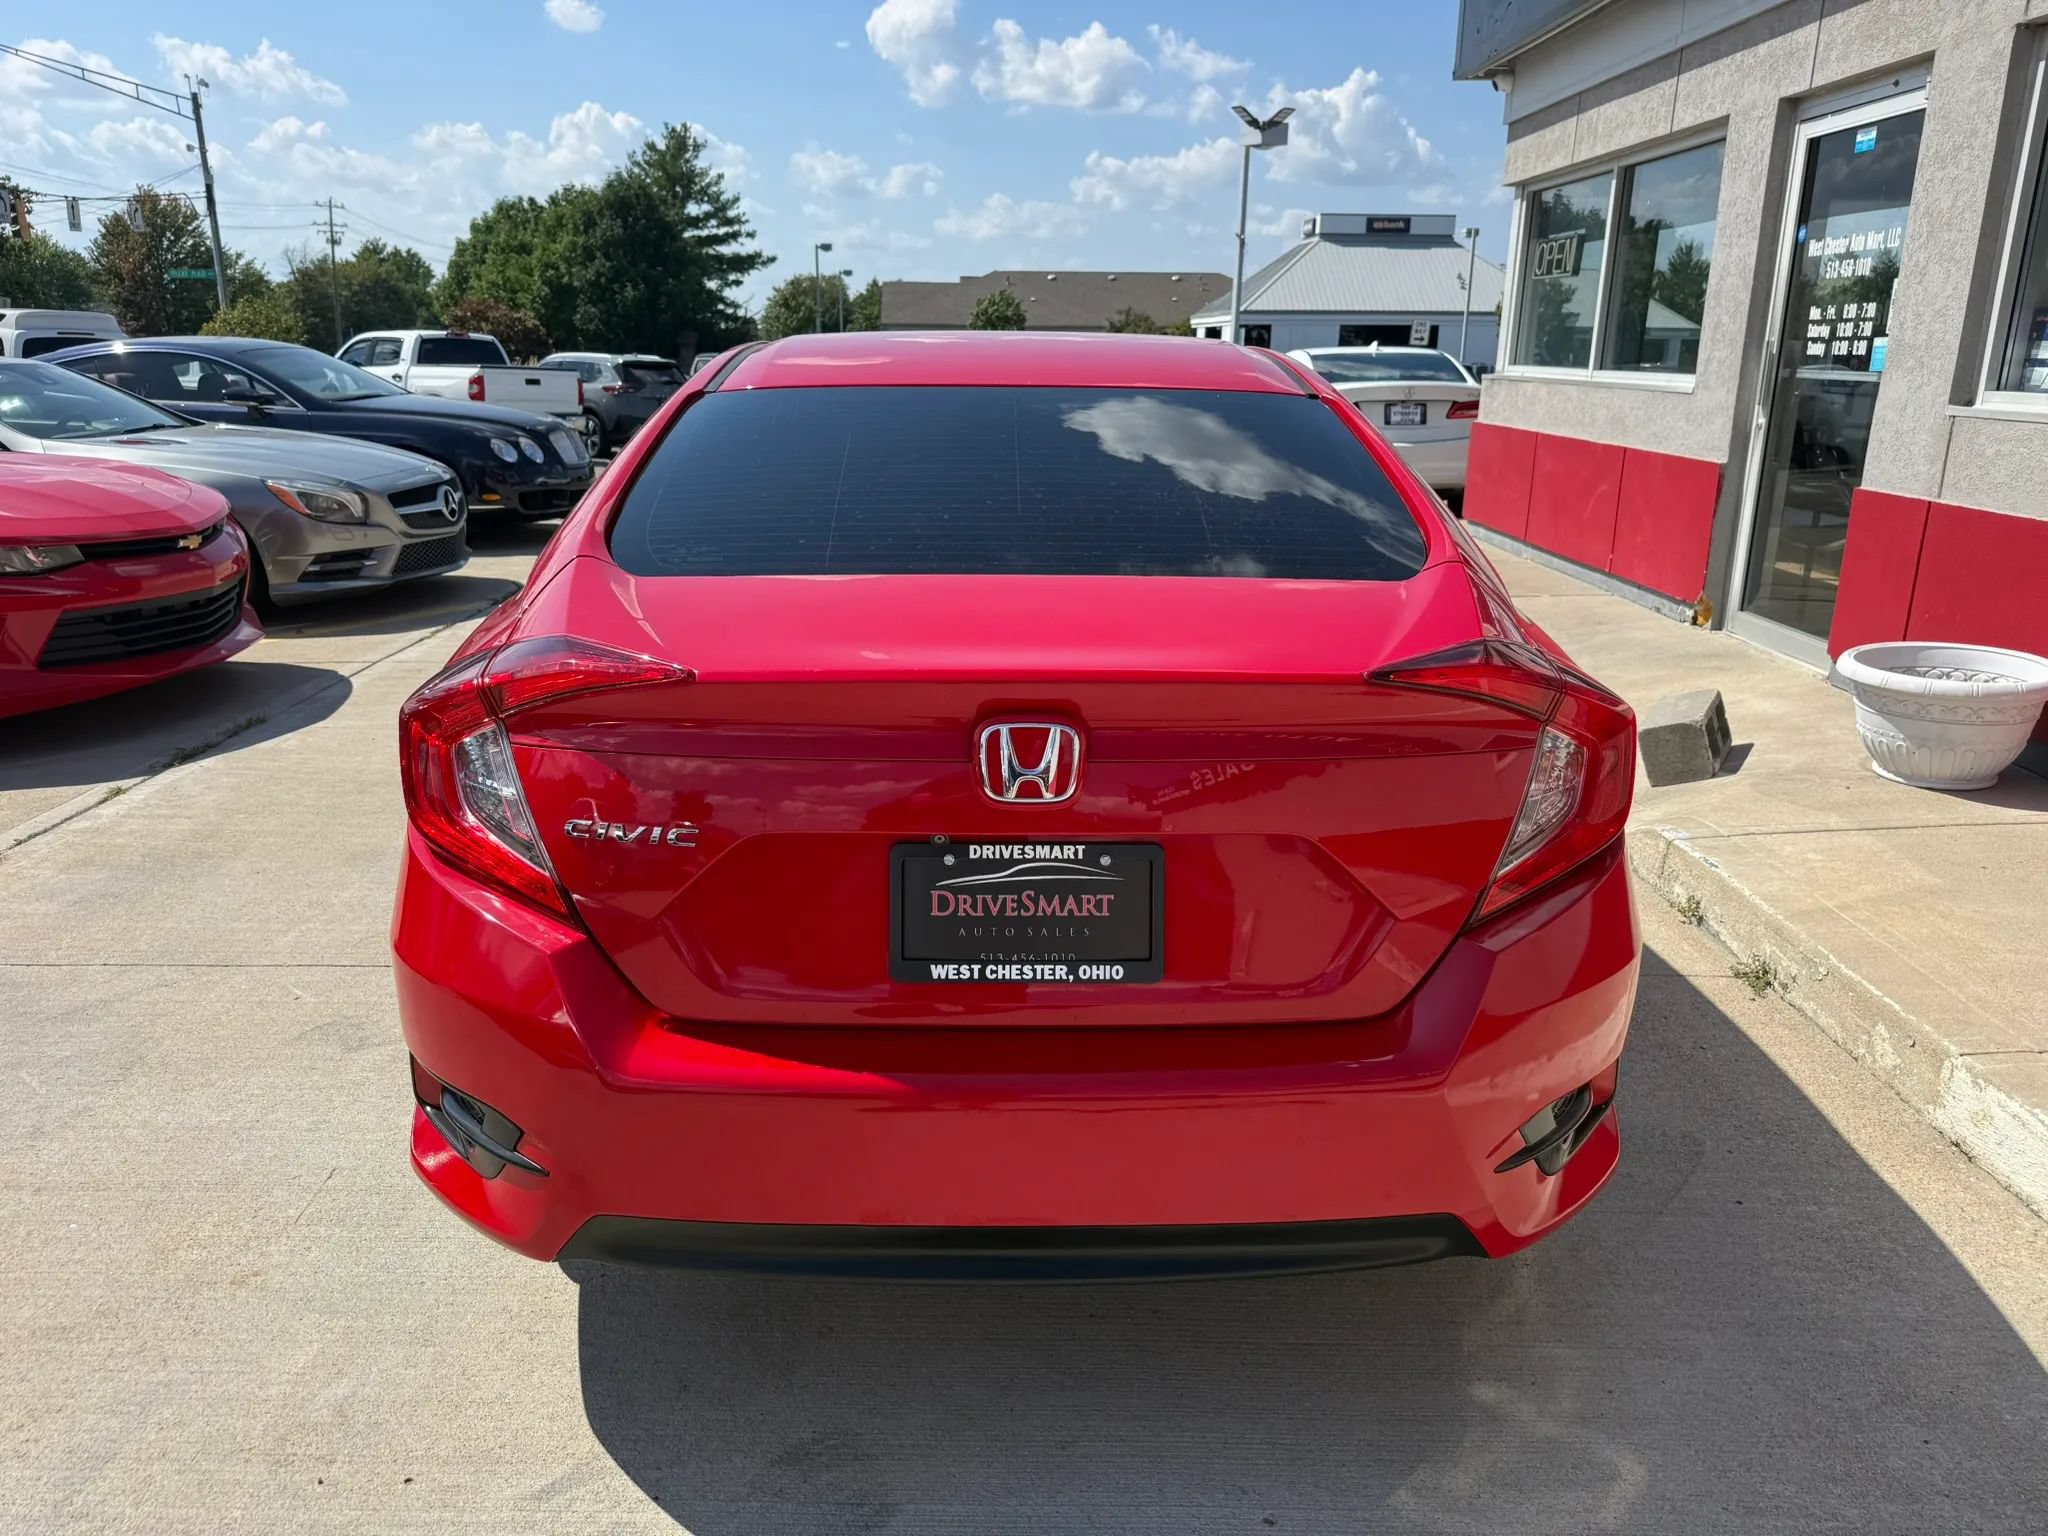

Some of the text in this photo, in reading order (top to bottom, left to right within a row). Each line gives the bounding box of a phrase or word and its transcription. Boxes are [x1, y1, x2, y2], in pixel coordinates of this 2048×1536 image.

[1808, 238, 1824, 257] West
[1824, 235, 1849, 255] Chester
[1849, 233, 1865, 252] Auto
[1887, 226, 1902, 248] LLC
[1536, 239, 1570, 276] OPEN
[1861, 302, 1877, 318] 7:00
[1807, 322, 1831, 340] Saturday
[1858, 321, 1873, 337] 7:00
[1806, 340, 1826, 358] Sunday
[564, 819, 699, 847] CIVIC
[969, 845, 1086, 859] DRIVESMART
[958, 927, 1091, 937] AUTO SALES
[930, 964, 1124, 982] WEST CHESTER, OHIO
